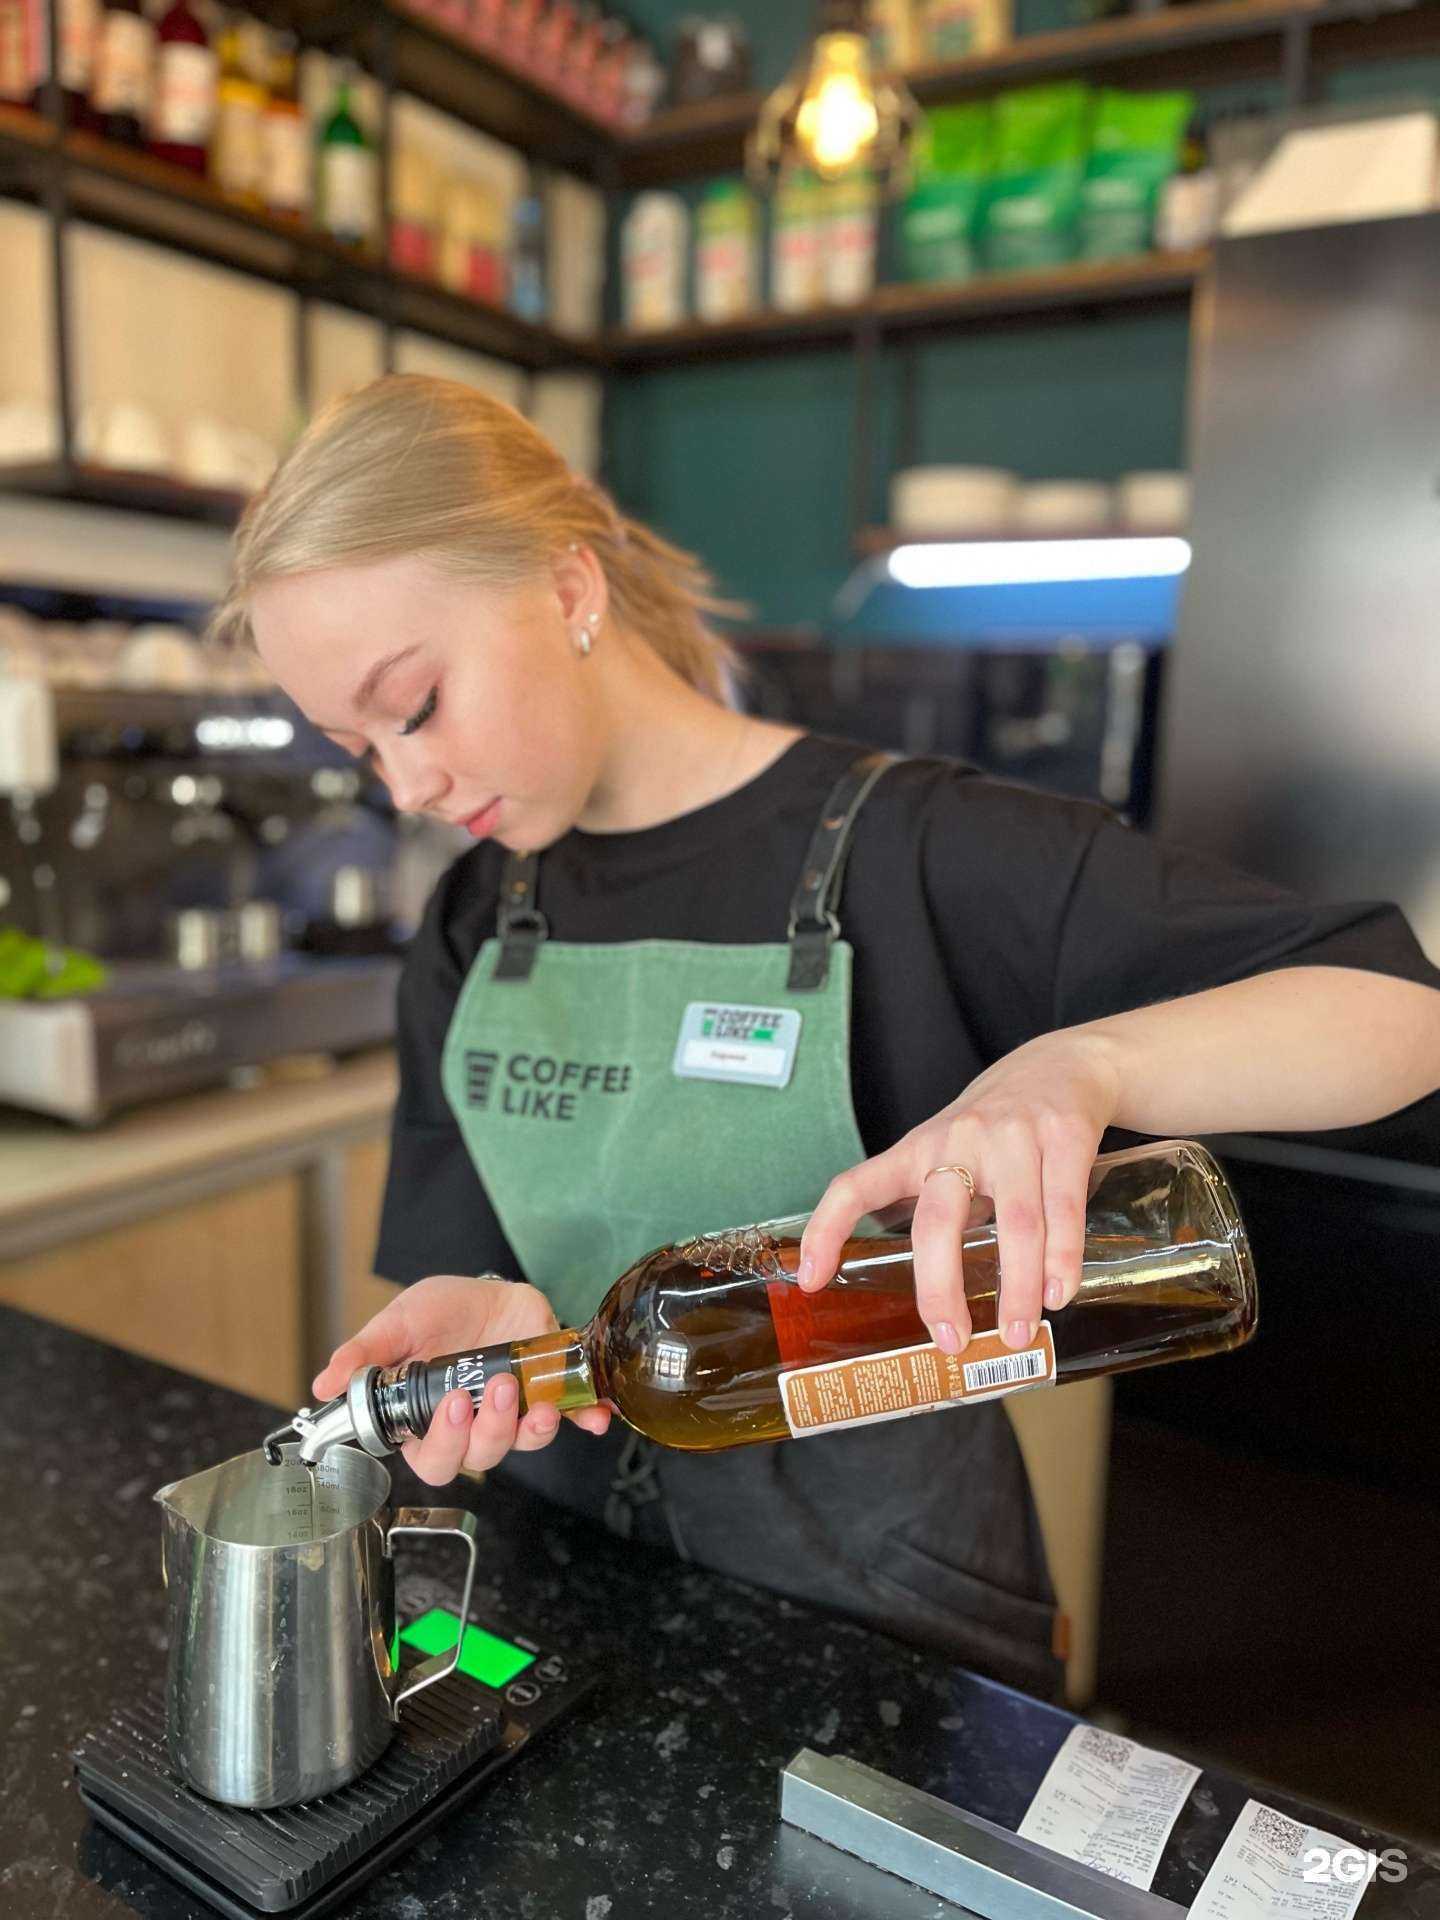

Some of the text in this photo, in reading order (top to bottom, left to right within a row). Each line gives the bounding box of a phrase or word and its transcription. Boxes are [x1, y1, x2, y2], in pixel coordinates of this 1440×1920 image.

[719, 1008, 783, 1029] COFFEE
[716, 1023, 752, 1041] LIKE
[501, 1086, 576, 1121] LIKE
